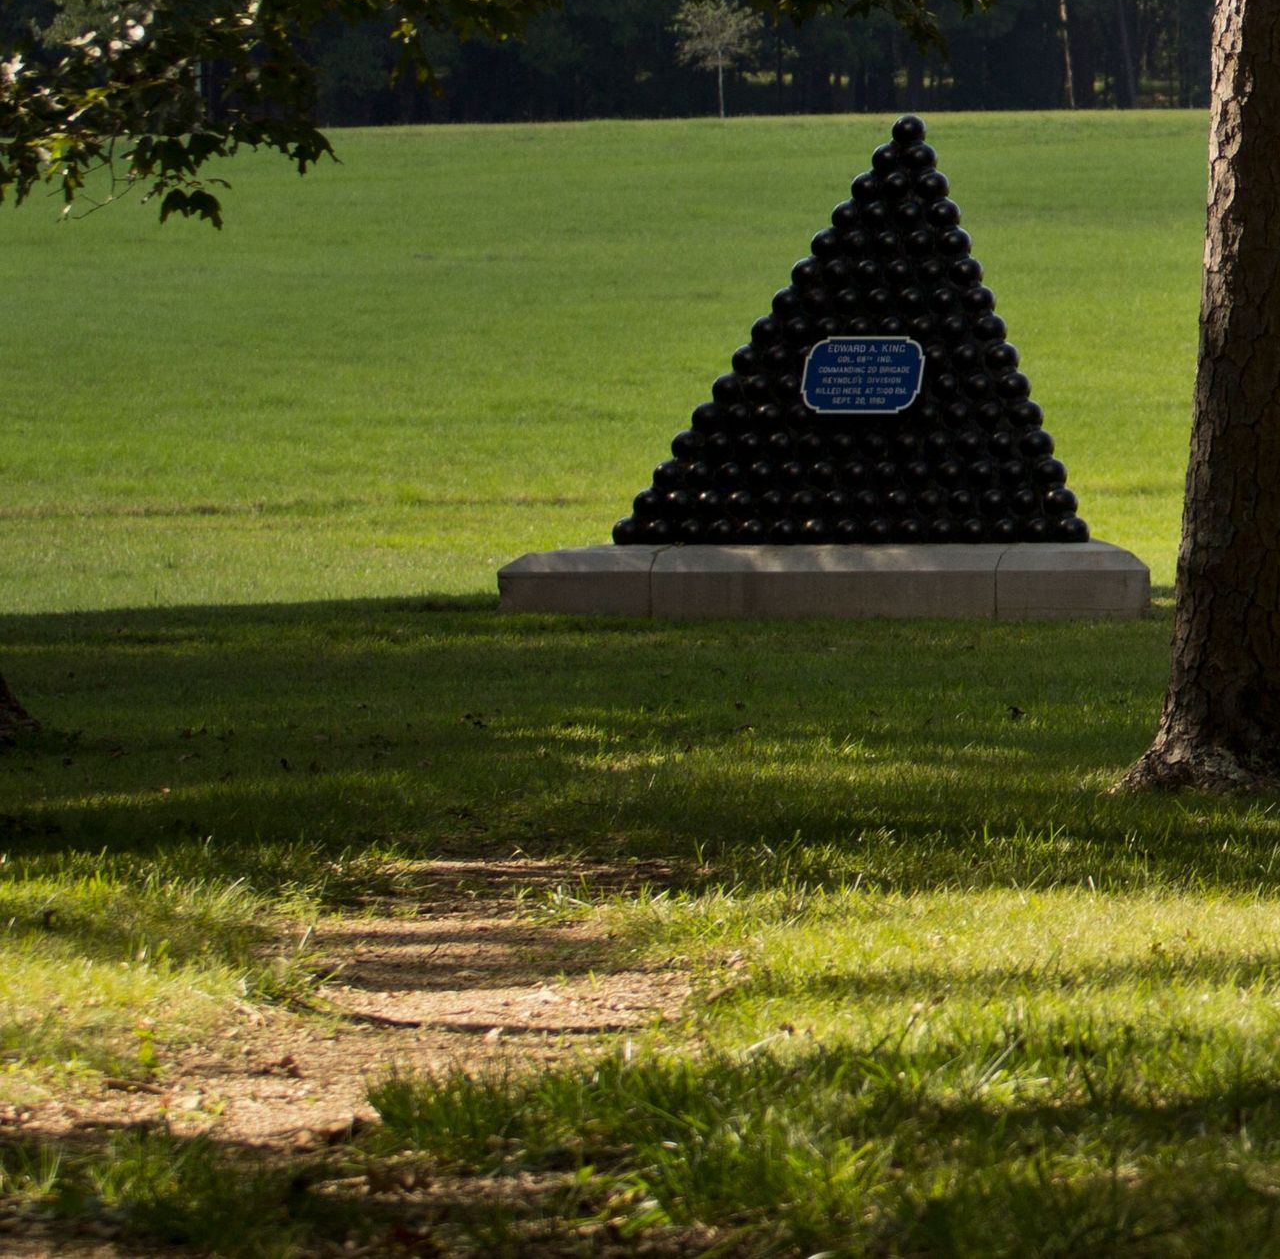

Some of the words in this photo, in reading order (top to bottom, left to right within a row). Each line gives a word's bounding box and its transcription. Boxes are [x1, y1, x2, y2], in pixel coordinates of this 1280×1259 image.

[828, 344, 866, 353] EDWARD
[869, 344, 878, 353] A.
[881, 344, 906, 353] KING
[818, 366, 866, 374] COMMANDING
[879, 366, 911, 374] BRIGADE
[866, 376, 902, 384] DIVISION
[815, 387, 840, 395] KILLED
[842, 387, 861, 395] HERE
[864, 387, 874, 395] AT
